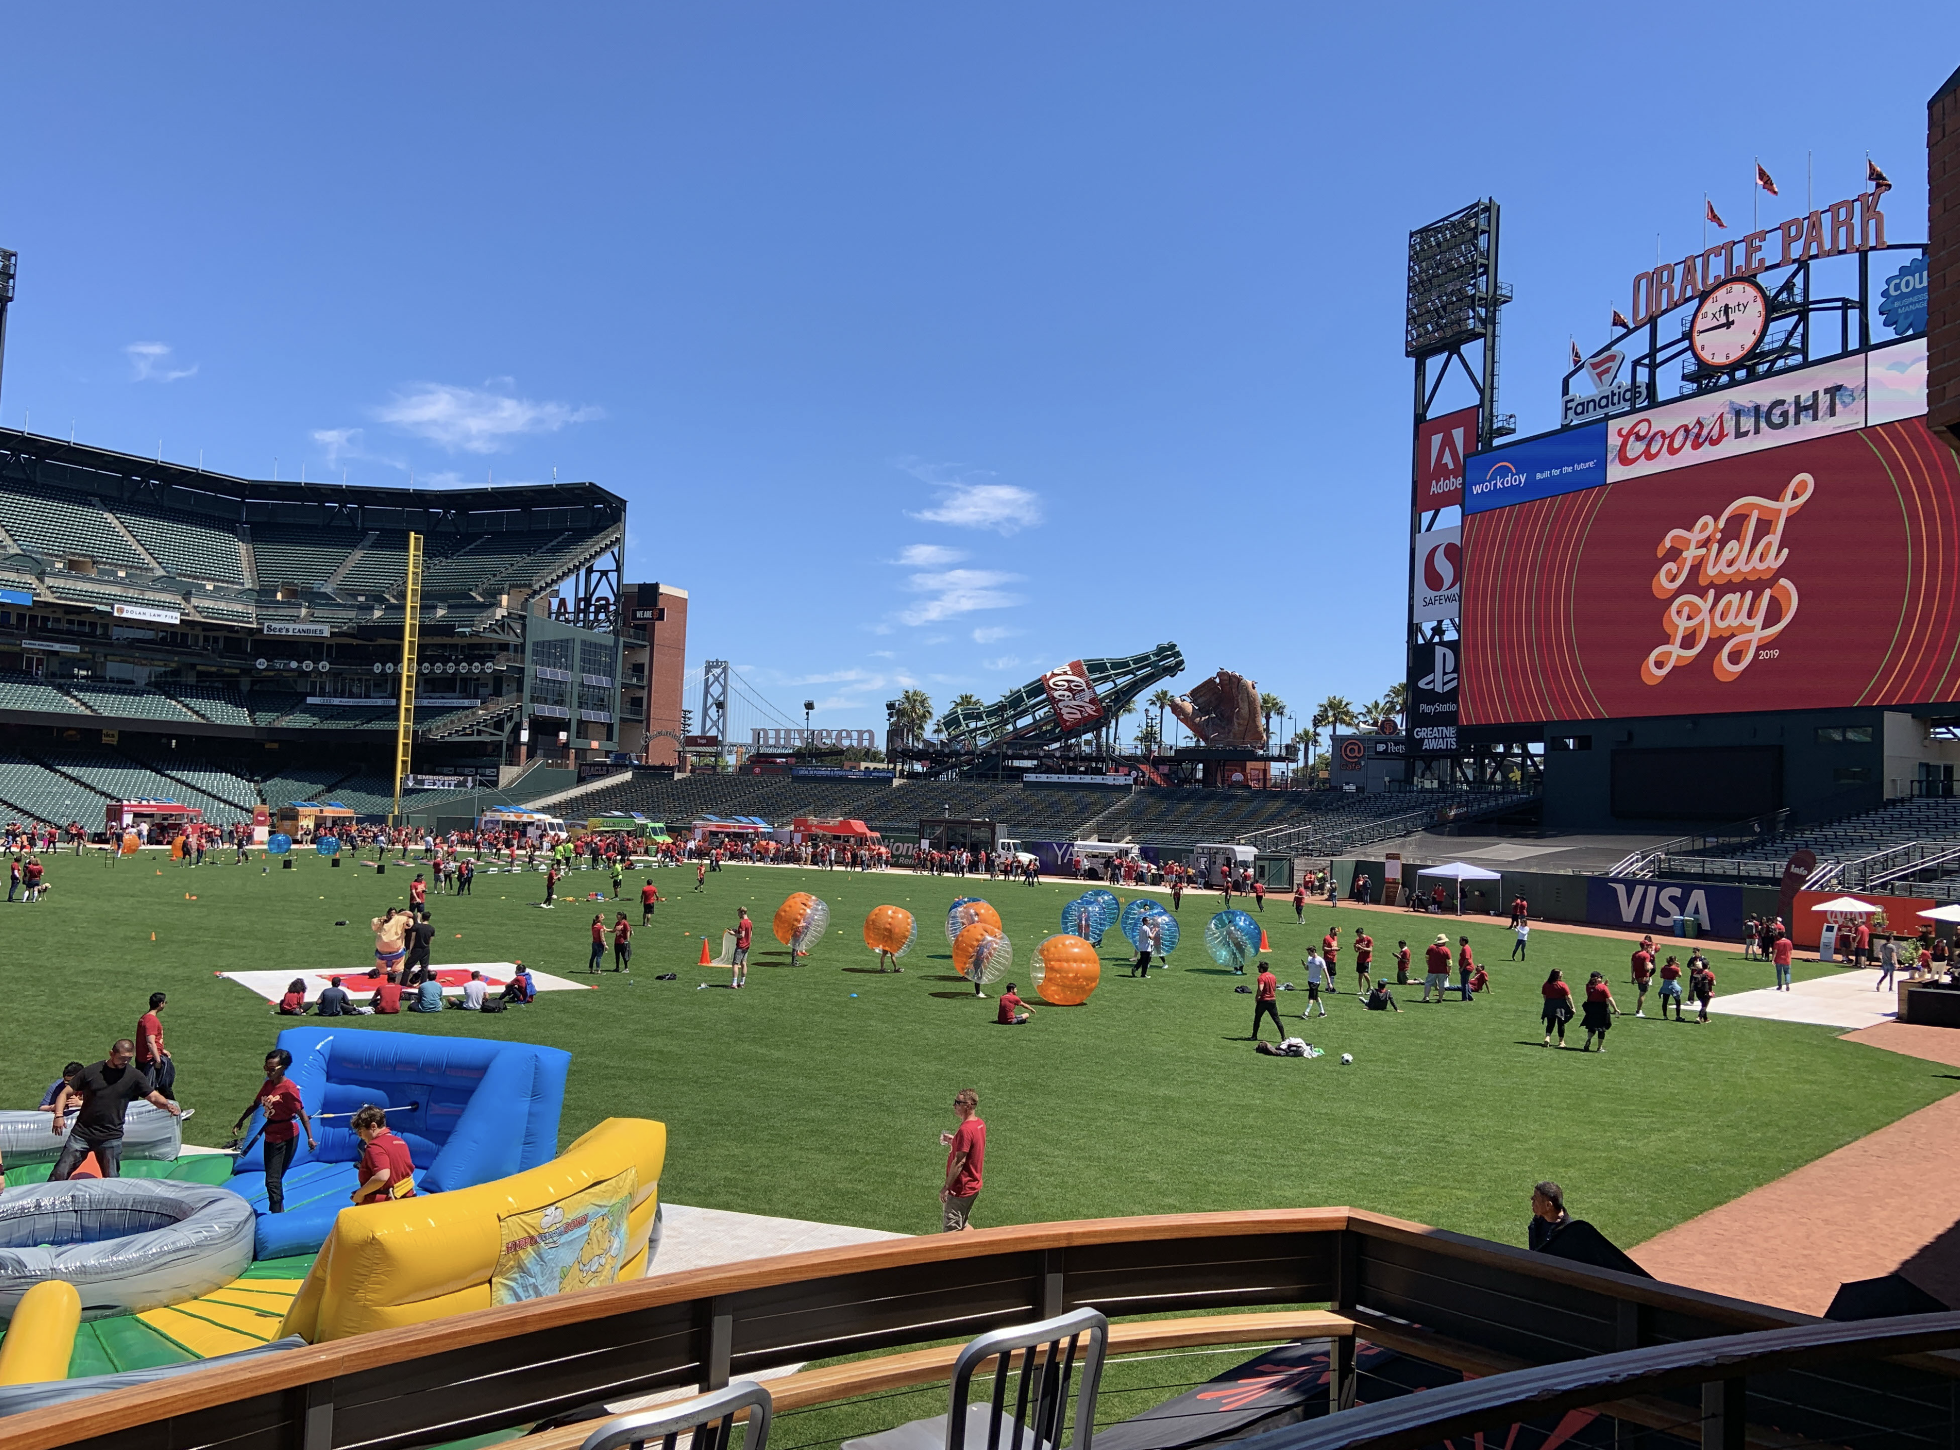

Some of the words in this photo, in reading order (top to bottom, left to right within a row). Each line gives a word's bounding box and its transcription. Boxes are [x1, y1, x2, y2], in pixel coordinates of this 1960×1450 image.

[1632, 230, 1766, 327] ORACLE
[1780, 185, 1887, 267] PARK
[1889, 271, 1928, 296] COU
[1711, 301, 1750, 322] xfnity
[1898, 301, 1928, 313] MANAGE
[1617, 412, 1729, 466] Coors
[1734, 384, 1844, 440] LIGHT
[1536, 471, 1550, 480] Built
[1562, 465, 1573, 474] the
[1430, 475, 1462, 495] Adobe
[1472, 473, 1527, 494] workday
[1655, 473, 1815, 594] Field
[266, 624, 290, 634] See's
[1646, 578, 1799, 681] Day
[1758, 650, 1780, 660] 2019
[1420, 702, 1457, 715] PlayStatio
[750, 728, 876, 749] nuveen
[1422, 738, 1457, 750] AWAITS
[424, 780, 458, 789] EXIT
[1790, 864, 1808, 876] Info
[1608, 883, 1711, 931] VISA
